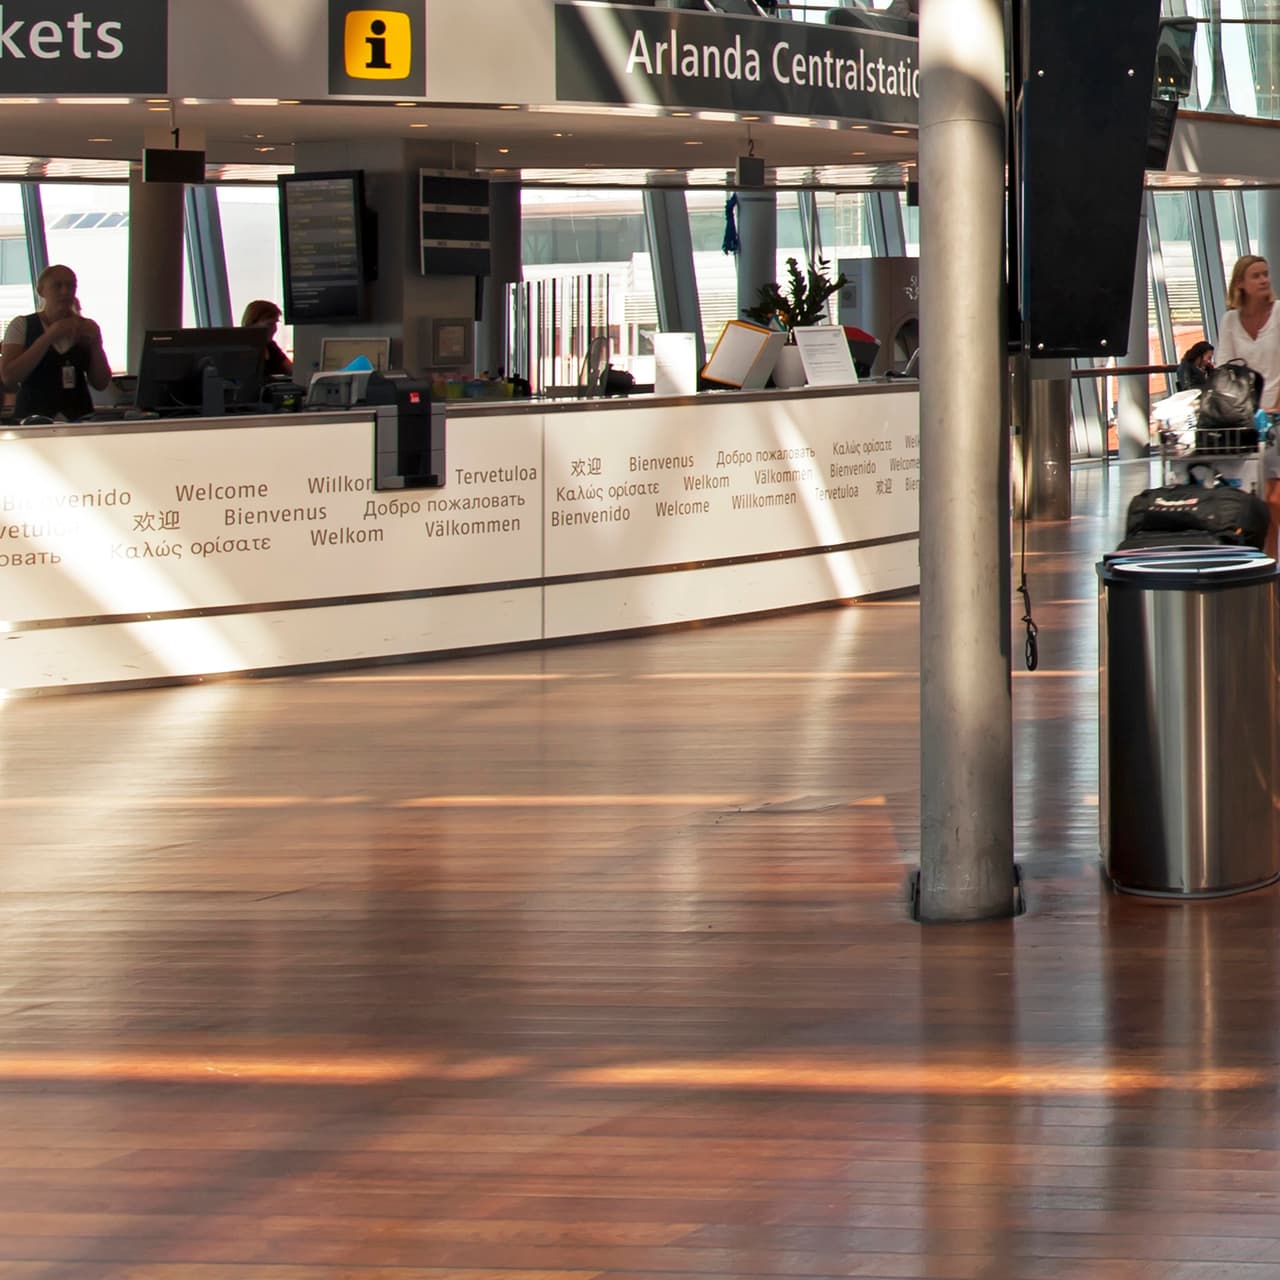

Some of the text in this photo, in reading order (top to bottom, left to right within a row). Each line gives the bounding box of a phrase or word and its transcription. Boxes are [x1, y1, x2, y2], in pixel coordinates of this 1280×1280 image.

[0, 4, 124, 60] kets
[626, 29, 919, 99] Arlanda Centralstatio
[170, 127, 180, 149] 1
[570, 457, 602, 477] 欢迎
[629, 455, 694, 472] Bienvenus
[716, 447, 816, 468] Добро пожаловать
[176, 483, 268, 502] Welcome
[308, 476, 373, 495] Willko
[455, 465, 538, 485] Tervetuloa
[683, 475, 730, 491] Welkom
[755, 469, 814, 485] Välkommen
[830, 460, 877, 478] Bienvenido
[556, 481, 660, 502] Καλώς ορίσατε
[224, 505, 328, 527] Bienvenus
[363, 494, 526, 520] Добро пожаловать
[551, 485, 859, 527] Bienvenido Welcome Willkommen Tervetuloa
[132, 510, 181, 533] 欢迎
[310, 517, 521, 547] Welkom Välkommen
[190, 536, 272, 558] ορίσατε
